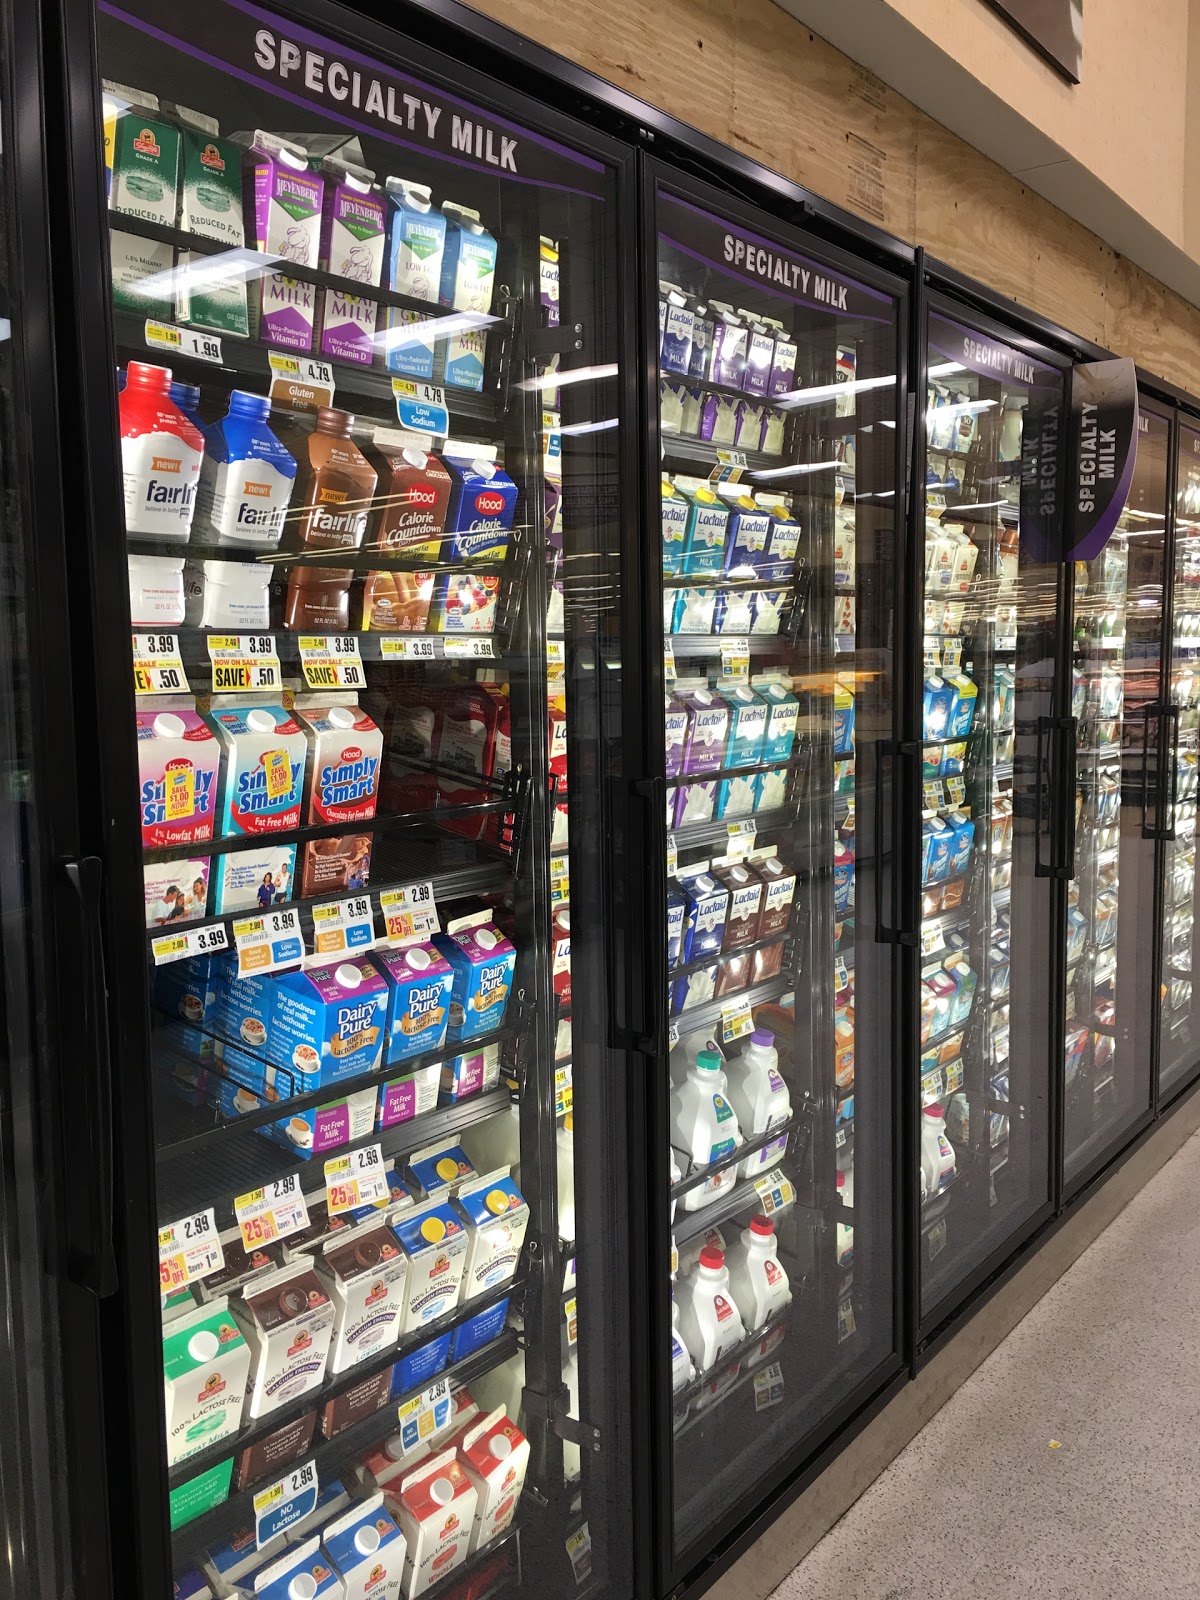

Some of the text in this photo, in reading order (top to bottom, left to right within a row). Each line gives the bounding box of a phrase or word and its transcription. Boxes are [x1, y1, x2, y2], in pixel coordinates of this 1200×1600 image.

[254, 29, 518, 173] SPECIALTY MILK
[276, 178, 319, 208] MEYENBERG
[339, 199, 384, 229] MEYENBERG
[189, 214, 226, 231] REDUCED
[227, 226, 242, 239] FAT
[723, 234, 848, 311] SPECIALTY MILK
[270, 285, 311, 308] MILK
[331, 300, 374, 324] MILK
[192, 338, 219, 358] 1.99
[963, 337, 1036, 384] SPECIALTY MILK
[308, 363, 330, 383] 4.79
[289, 385, 315, 399] Gluten
[424, 386, 442, 403] 4.79
[292, 398, 309, 409] Free
[415, 406, 430, 417] Low
[411, 415, 436, 428] Sodium
[1078, 402, 1098, 513] SPECIALTY
[1099, 428, 1116, 479] MILK
[156, 460, 178, 471] new!
[147, 480, 197, 505] fairli
[248, 485, 268, 495] new!
[409, 488, 435, 504] Hood
[478, 497, 502, 510] Hood
[399, 512, 434, 527] Calorie
[662, 509, 686, 522] actaid
[698, 511, 727, 528] Lactaid
[386, 523, 442, 546] Countdown
[469, 518, 501, 534] Calorie
[740, 518, 768, 533] Lactaid
[457, 530, 508, 551] Countdown
[773, 529, 799, 542] Lactaid
[147, 636, 175, 653] 3.99
[250, 637, 272, 653] 3.99
[335, 638, 356, 653] 3.99
[413, 643, 433, 656] 3.99
[473, 643, 492, 656] 3.99
[159, 669, 181, 689] .50
[215, 668, 274, 687] SAVE .50
[305, 666, 360, 684] SAVE .50
[697, 713, 726, 727] Lactaid
[739, 709, 765, 723] Lactaid
[773, 705, 798, 719] Lactaid
[665, 716, 686, 730] ctaid
[342, 749, 360, 759] Hood
[699, 752, 714, 761] MILK
[237, 762, 302, 793] Simy
[270, 765, 285, 776] SAVE
[270, 771, 287, 783] $1.00
[321, 757, 378, 787] Simply
[141, 770, 214, 803] Sily
[171, 786, 187, 794] SAVE
[321, 779, 374, 807] Smart
[169, 792, 189, 802] $1.00
[255, 811, 297, 827] Fat Free Milk
[155, 824, 210, 841] 1% Lowfat Milk
[411, 887, 430, 903] 2.99
[734, 888, 760, 905] Lactaid
[769, 880, 794, 896] Lactaid
[347, 900, 368, 917] 3.99
[699, 898, 726, 916] Lactaid
[272, 913, 295, 932] 3.99
[403, 925, 412, 936] OFF
[198, 930, 226, 949] 3.99
[351, 934, 368, 943] Sodium
[278, 949, 298, 958] Sodium
[480, 961, 508, 982] Dairy
[409, 982, 445, 1007] Dairy
[480, 977, 503, 996] Pure
[220, 990, 263, 1018] lactose worries.
[277, 991, 317, 1016] The goodness
[410, 1000, 439, 1019] Pure
[282, 1013, 306, 1031] without
[338, 1001, 377, 1026] Dairy
[415, 1013, 431, 1025] 100%
[272, 1016, 291, 1033] lactose
[291, 1026, 317, 1044] worries.
[339, 1017, 372, 1040] Pure
[404, 1014, 440, 1034] Lactose Free
[333, 1035, 374, 1057] Lactose Free
[346, 1032, 364, 1047] 100%
[389, 1093, 412, 1107] Fat Free
[393, 1102, 406, 1112] Milk
[319, 1119, 345, 1134] Fat Free
[324, 1128, 340, 1140] Milk
[358, 1149, 379, 1169] 2.99
[273, 1177, 296, 1199] 2.99
[330, 1183, 354, 1207] 25%
[347, 1193, 358, 1207] OFF
[184, 1213, 210, 1239] 2.99
[244, 1217, 270, 1242] 25%
[263, 1227, 275, 1240] OFF
[172, 1268, 185, 1284] OFF
[409, 1275, 461, 1306] 100% LACTOSE FREE
[412, 1285, 456, 1313] CALCIUM ENRICHED
[344, 1301, 400, 1336] 100% LACTOSE FREE
[347, 1313, 396, 1344] CALCIUM ENRICHED
[263, 1352, 326, 1389] 100% LACTOSE FREE
[267, 1362, 320, 1394] CALCIUM ENRICHED
[429, 1381, 446, 1402] 2.99
[171, 1394, 243, 1437] 100% LACTOSE FREE
[172, 1428, 231, 1464] LOWFAT MILK
[291, 1466, 314, 1491] 2.99
[280, 1503, 294, 1517] NO
[272, 1509, 301, 1532] Lactose
[491, 1513, 512, 1535] WHOLE
[420, 1529, 470, 1569] 100% LACTOSE FREE
[428, 1562, 454, 1584] WHOLE
